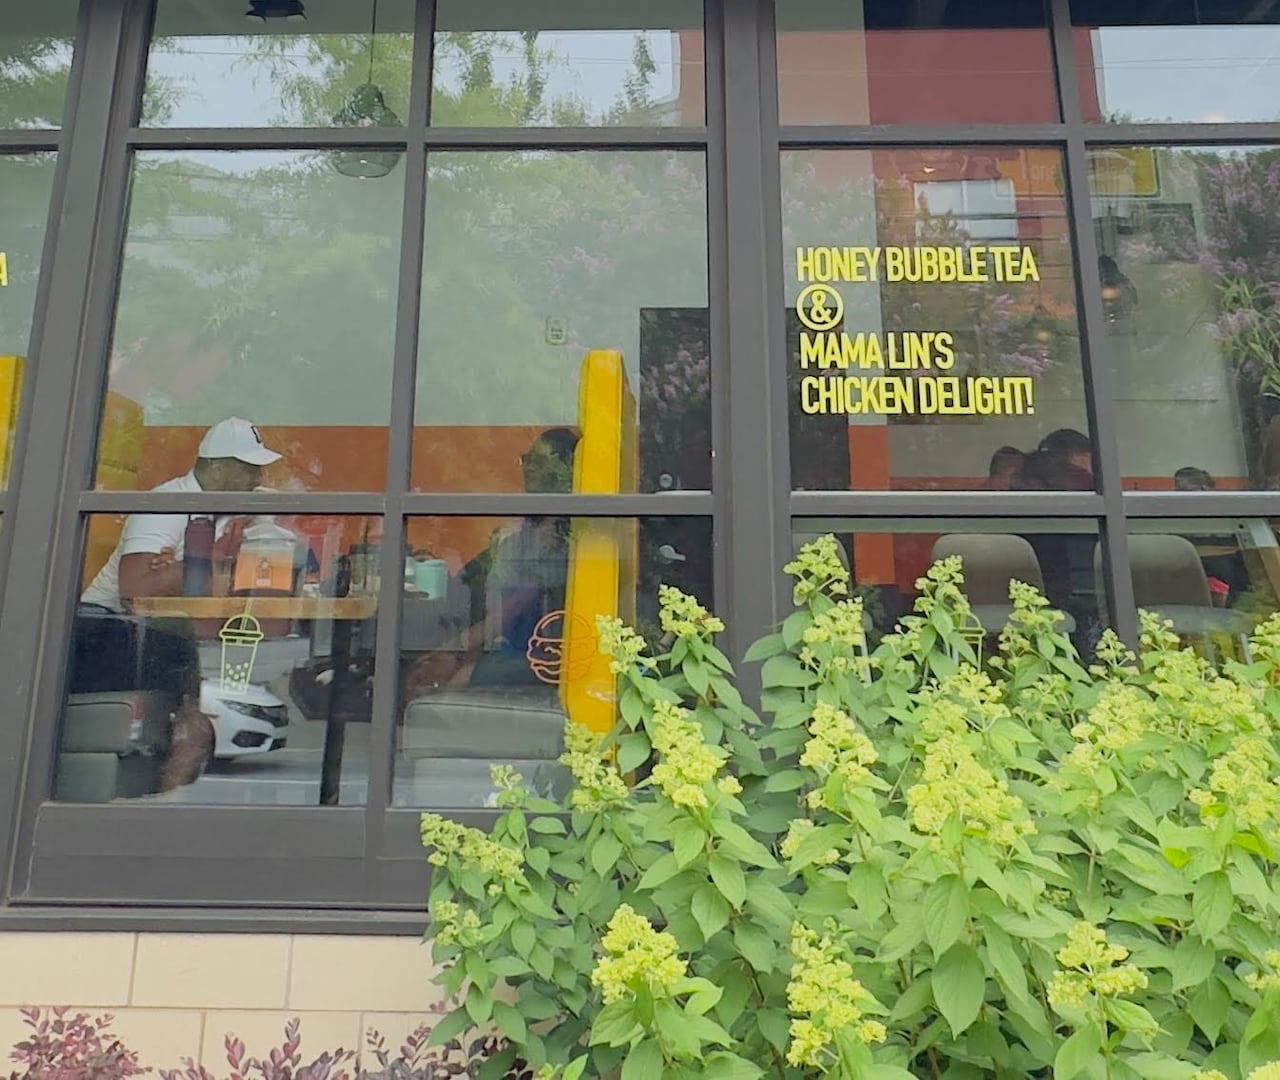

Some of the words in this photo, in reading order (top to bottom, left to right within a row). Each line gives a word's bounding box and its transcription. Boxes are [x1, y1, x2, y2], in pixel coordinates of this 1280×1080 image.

[796, 246, 881, 282] HONEY
[886, 246, 989, 282] BUBBLE
[990, 246, 1040, 282] TEA
[799, 332, 884, 369] MAMA
[888, 332, 954, 370] LIN'S
[800, 376, 914, 414] CHICKEN
[919, 376, 1035, 415] DELIGHT!
